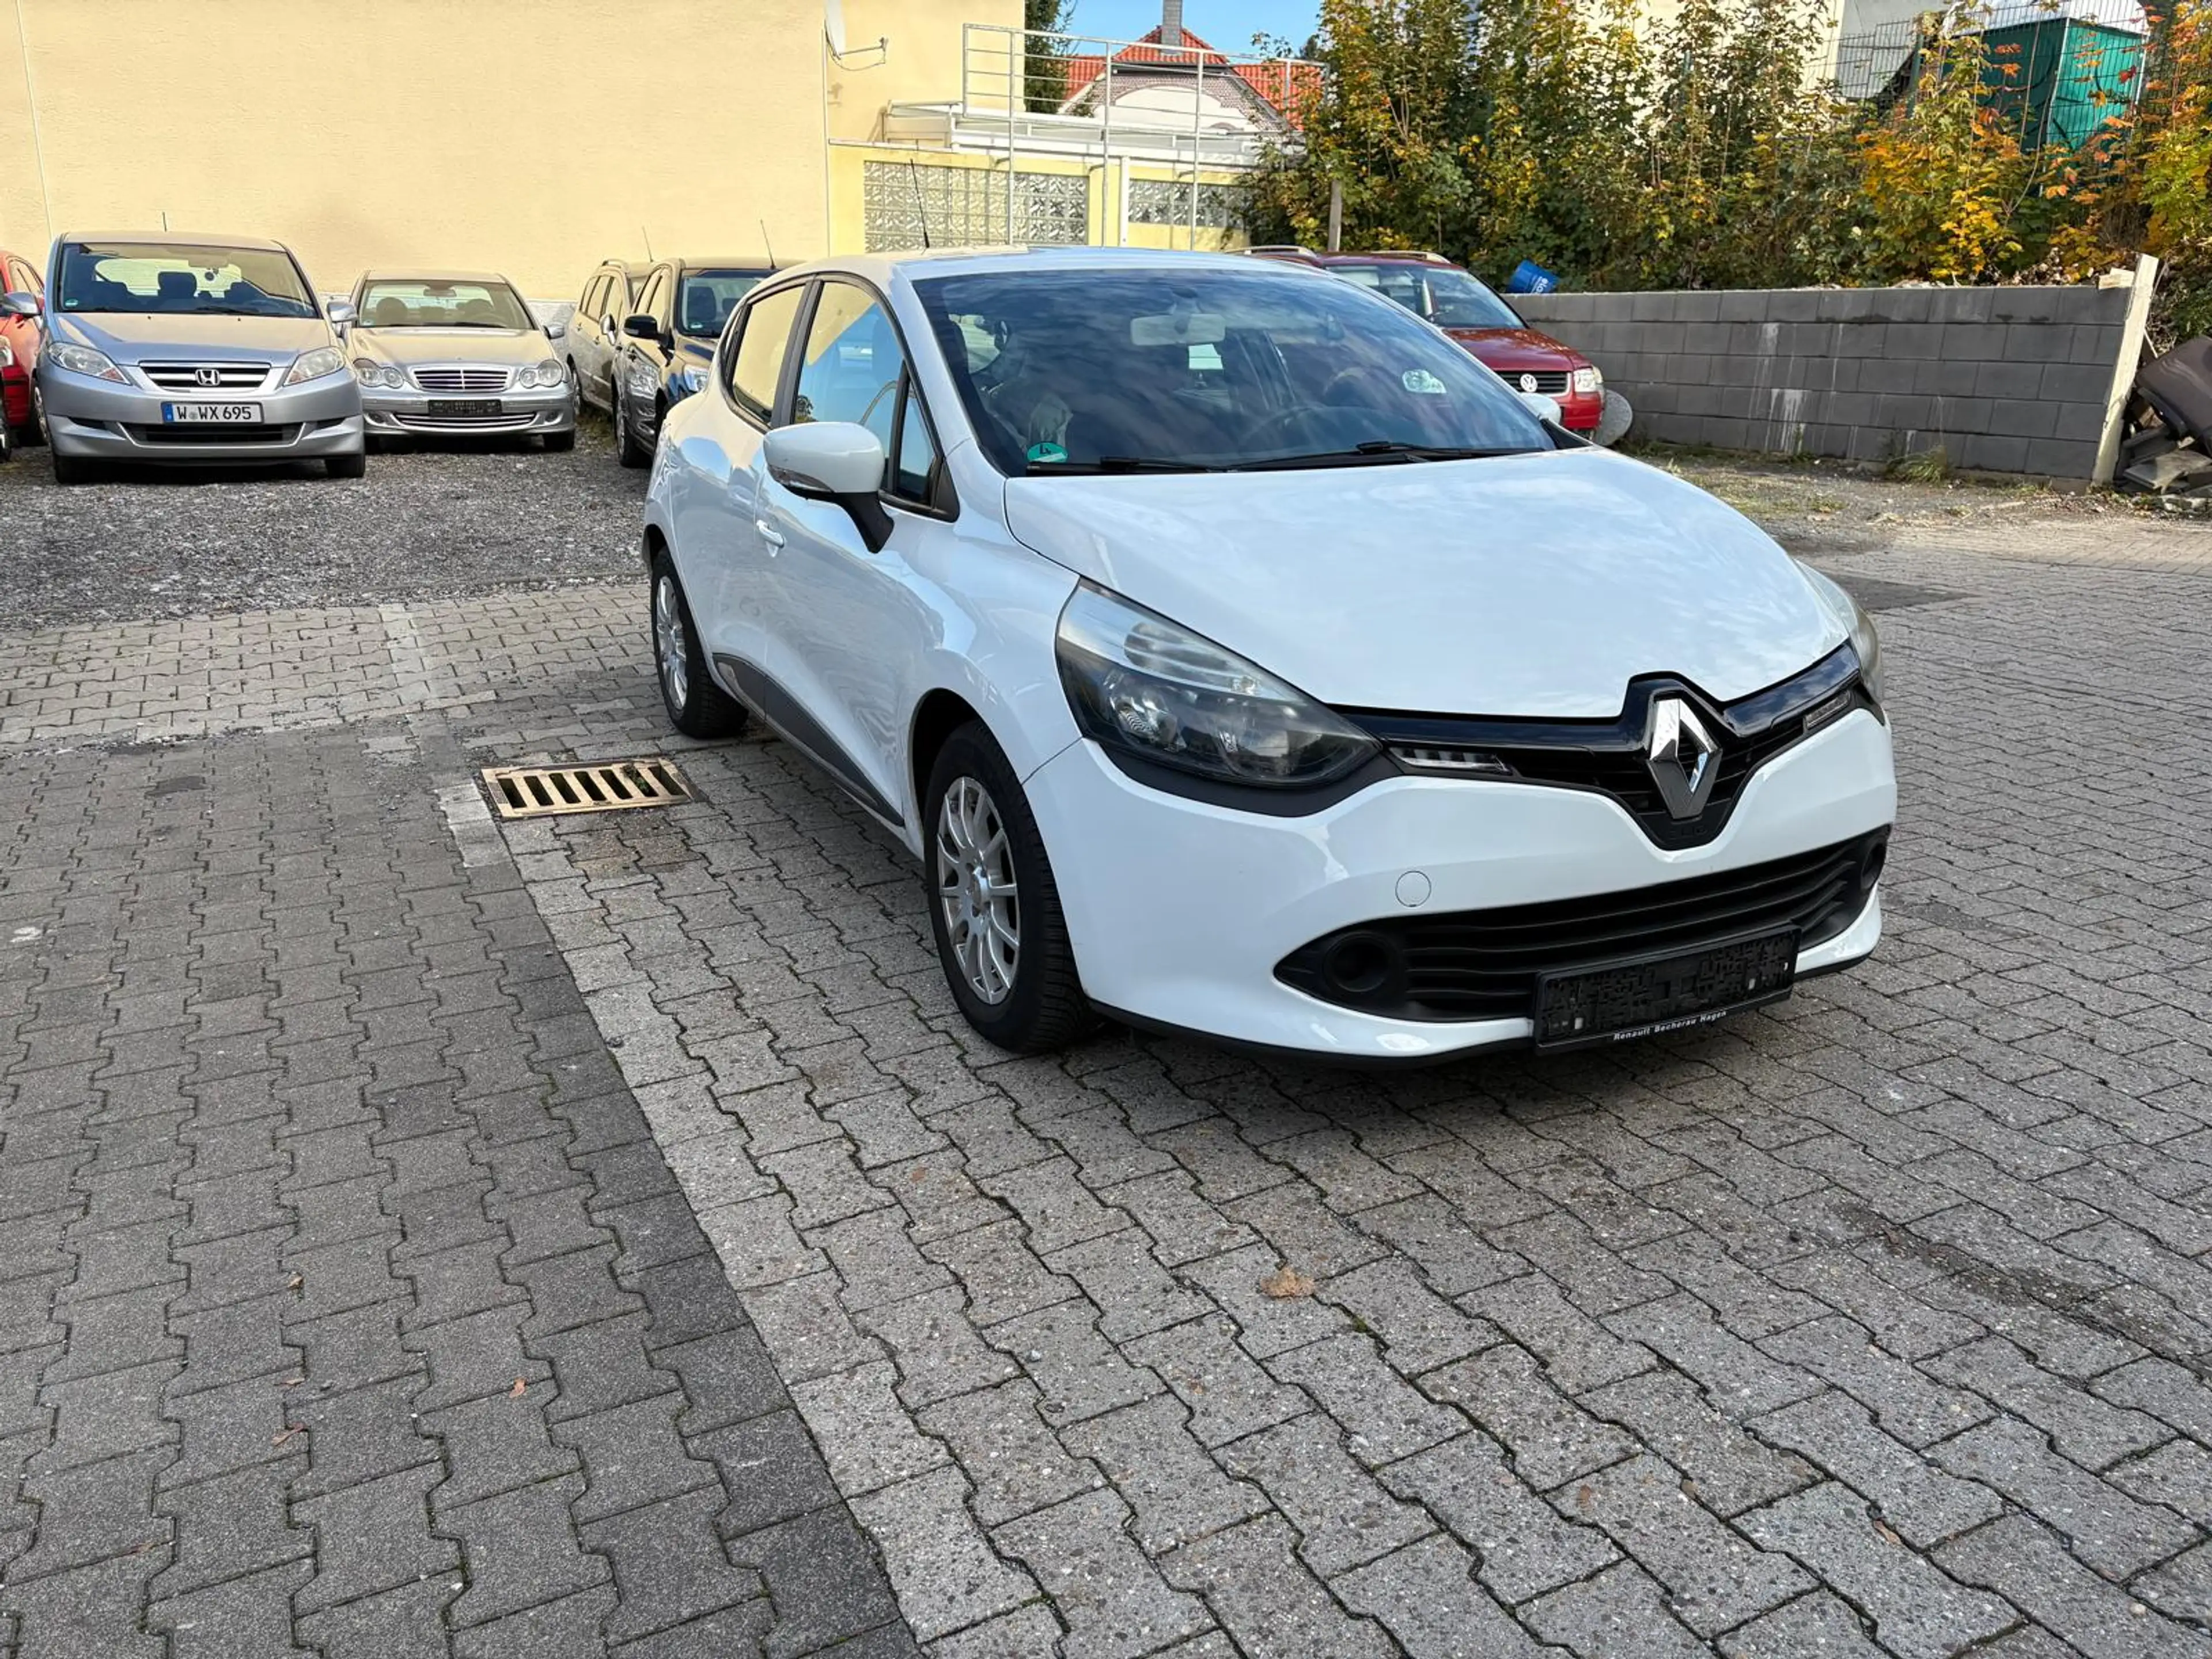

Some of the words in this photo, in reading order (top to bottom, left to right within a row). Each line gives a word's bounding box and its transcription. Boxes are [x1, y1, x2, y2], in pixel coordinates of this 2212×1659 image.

[177, 406, 187, 419] W
[198, 406, 219, 419] WX
[223, 406, 251, 419] 695
